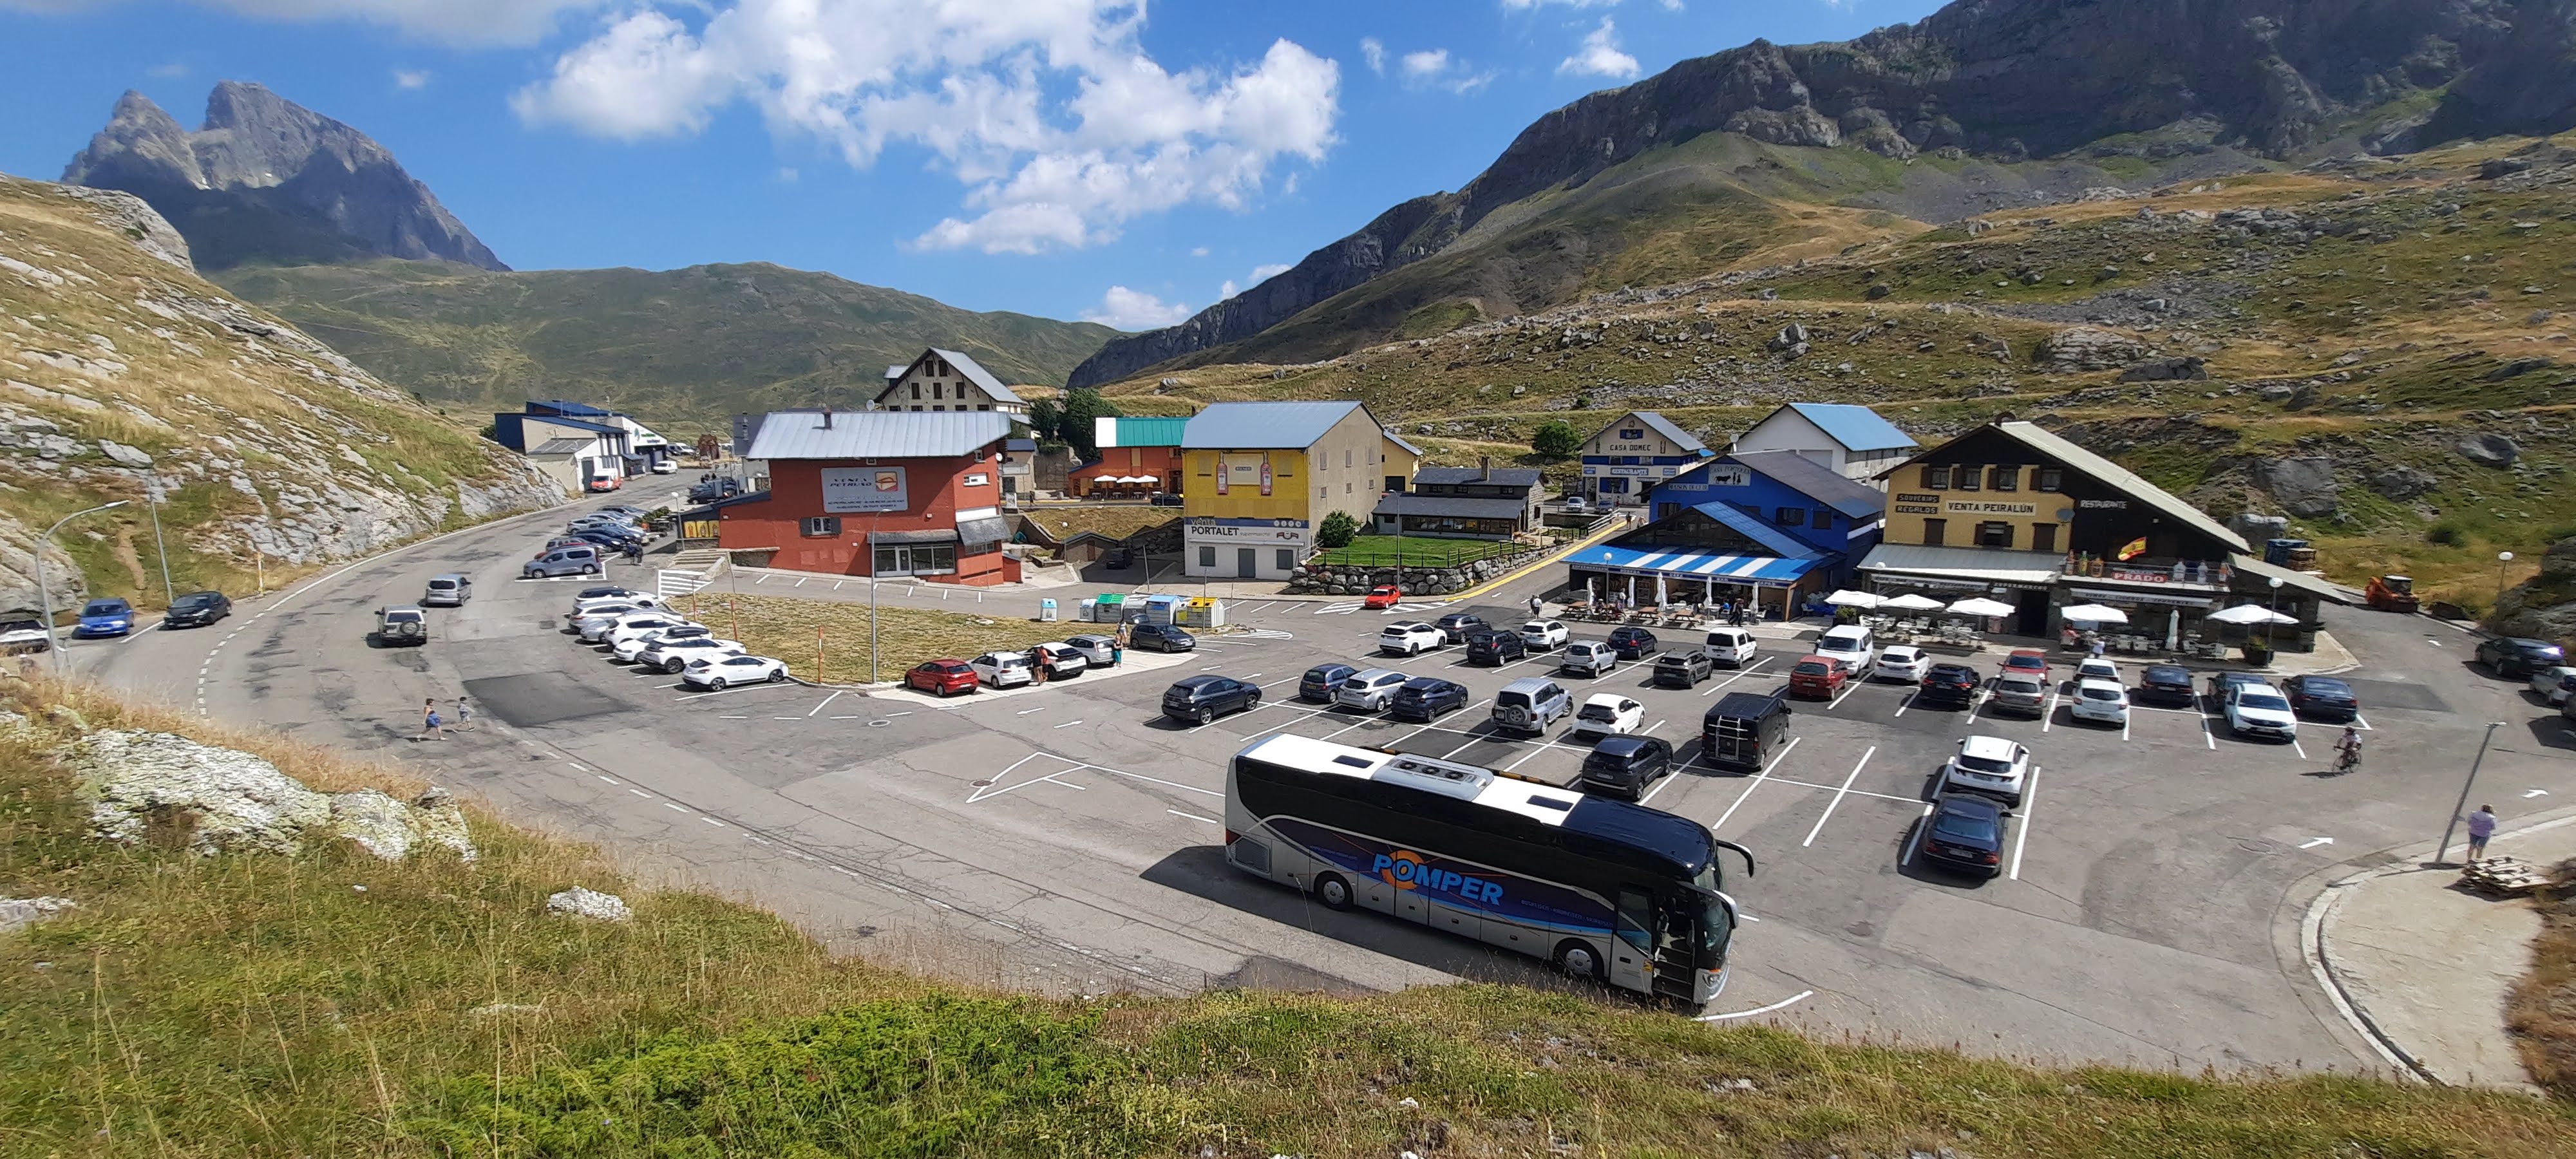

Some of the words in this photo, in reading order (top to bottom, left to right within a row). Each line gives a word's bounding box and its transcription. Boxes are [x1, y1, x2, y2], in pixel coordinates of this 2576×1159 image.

[1949, 502, 1980, 511] VENTA
[1984, 504, 2034, 513] PEIRALÚN
[2080, 500, 2128, 509] RESTAURANTE
[1191, 526, 1239, 536] PORTALET
[2114, 572, 2164, 583] PRADO
[1372, 853, 1504, 906] POMPER
